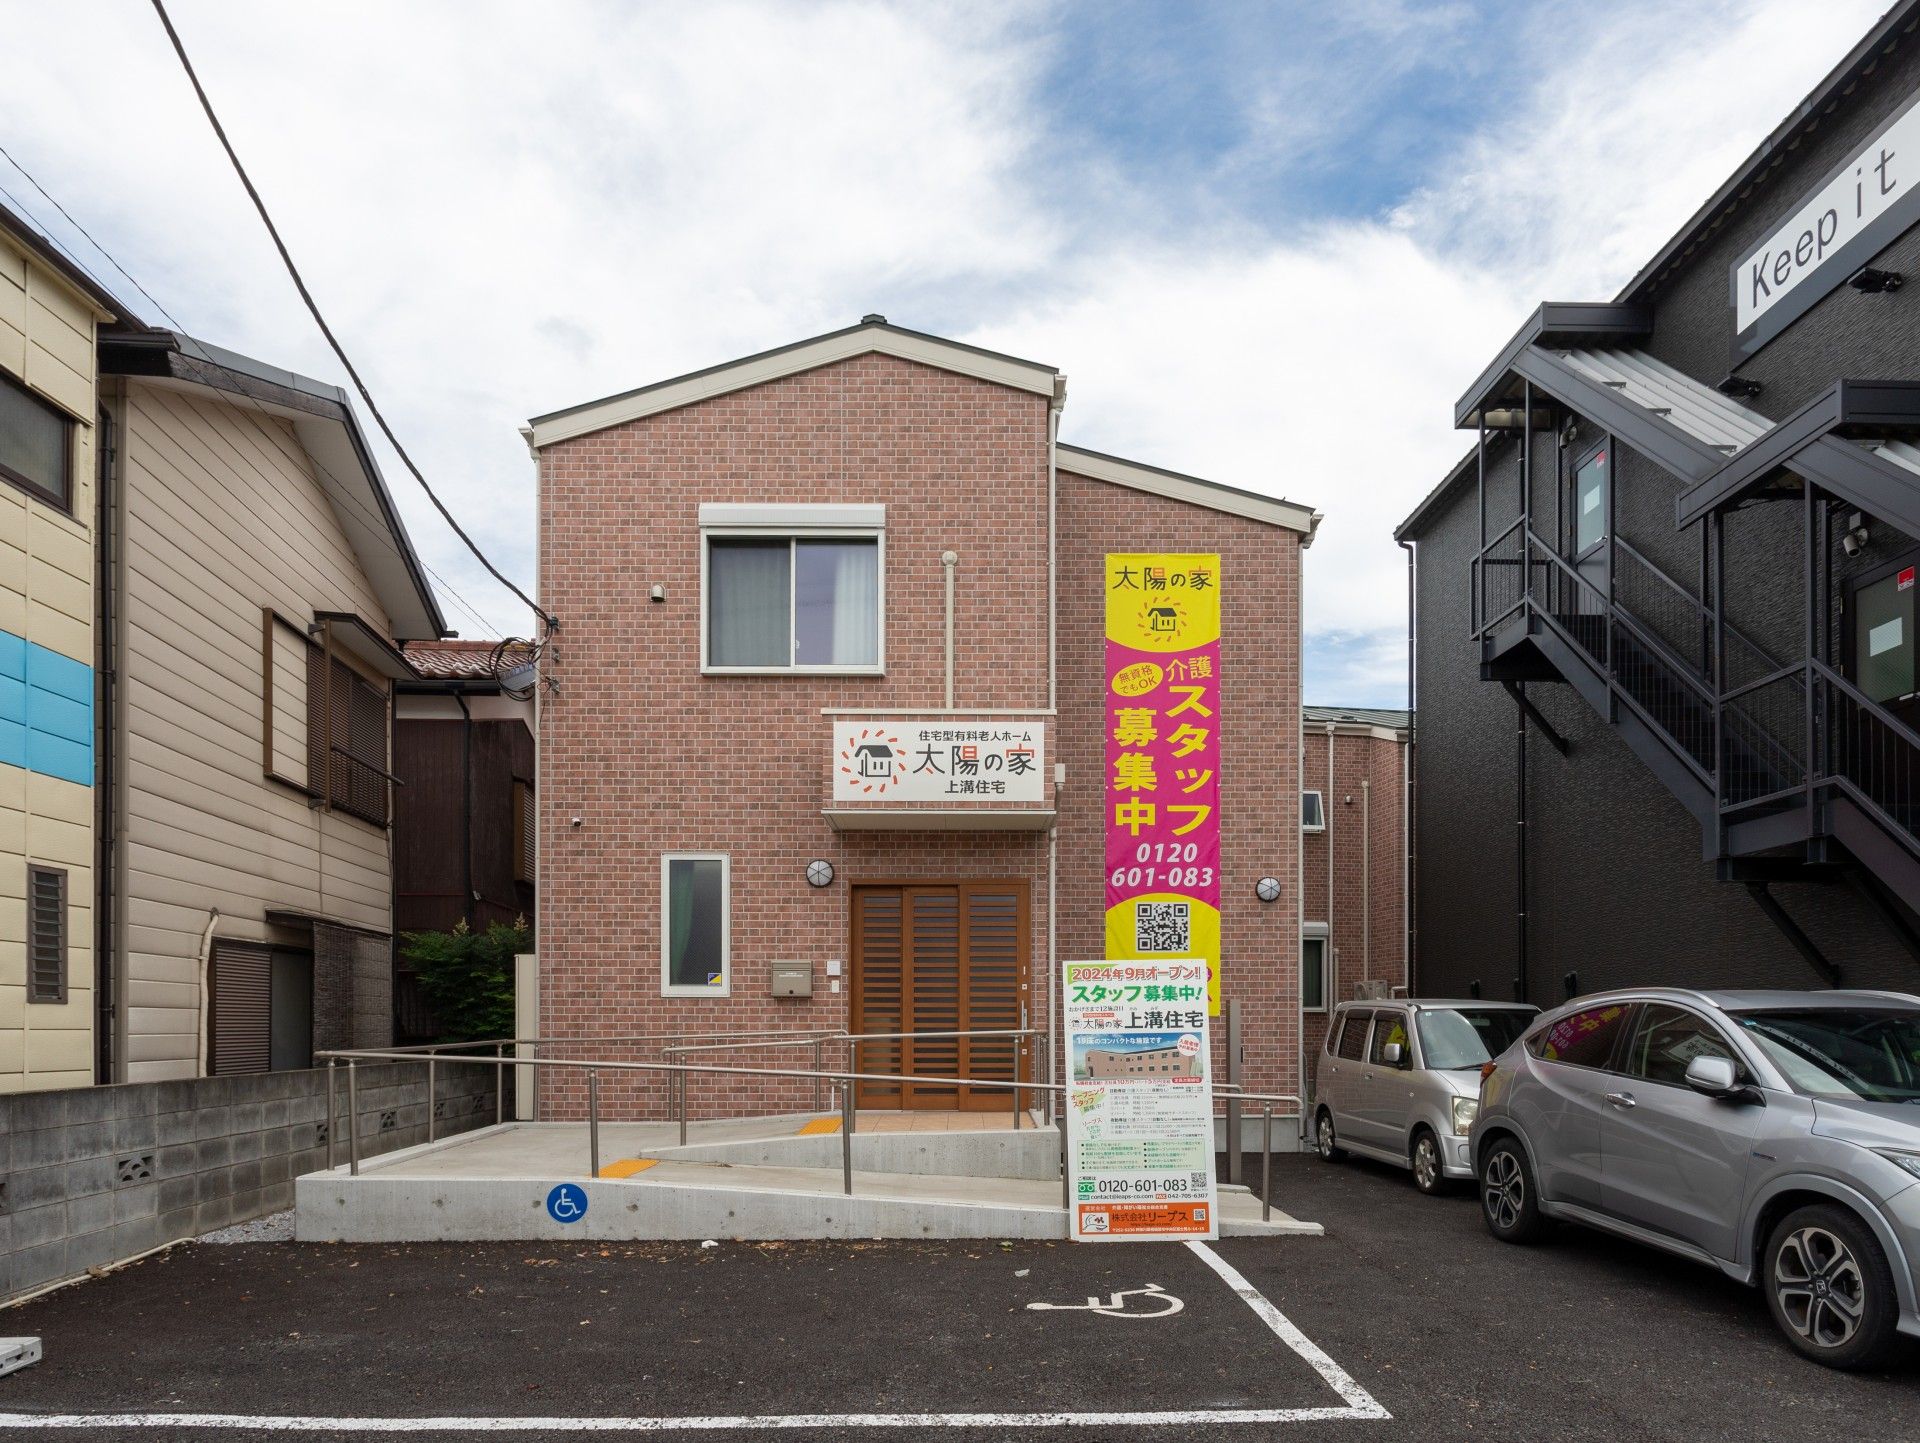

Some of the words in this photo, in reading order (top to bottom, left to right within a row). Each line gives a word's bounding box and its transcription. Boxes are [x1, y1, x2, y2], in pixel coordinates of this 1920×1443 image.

[1753, 208, 1838, 309] Keep
[1856, 148, 1897, 219] it
[1112, 565, 1213, 591] 太陽の家
[1119, 664, 1153, 685] 無資格
[1166, 655, 1214, 683] 介護
[1120, 676, 1158, 694] でもOK
[918, 730, 1032, 742] 住宅型有料老人ホーム
[912, 743, 1036, 776] 太陽の家
[1165, 685, 1214, 836] スタッフ
[1113, 707, 1158, 836] 募集中
[945, 780, 1006, 794] 上溝住宅
[1136, 843, 1198, 863] 0120
[1111, 867, 1213, 887] 601-083
[1072, 985, 1203, 1003] スタッフ募集中!
[1083, 1018, 1123, 1029] 太陽の家
[1124, 1010, 1204, 1029] 上溝住宅
[1099, 1179, 1187, 1192] 0120-601-083
[1112, 1210, 1189, 1222] 株式会社リープス
